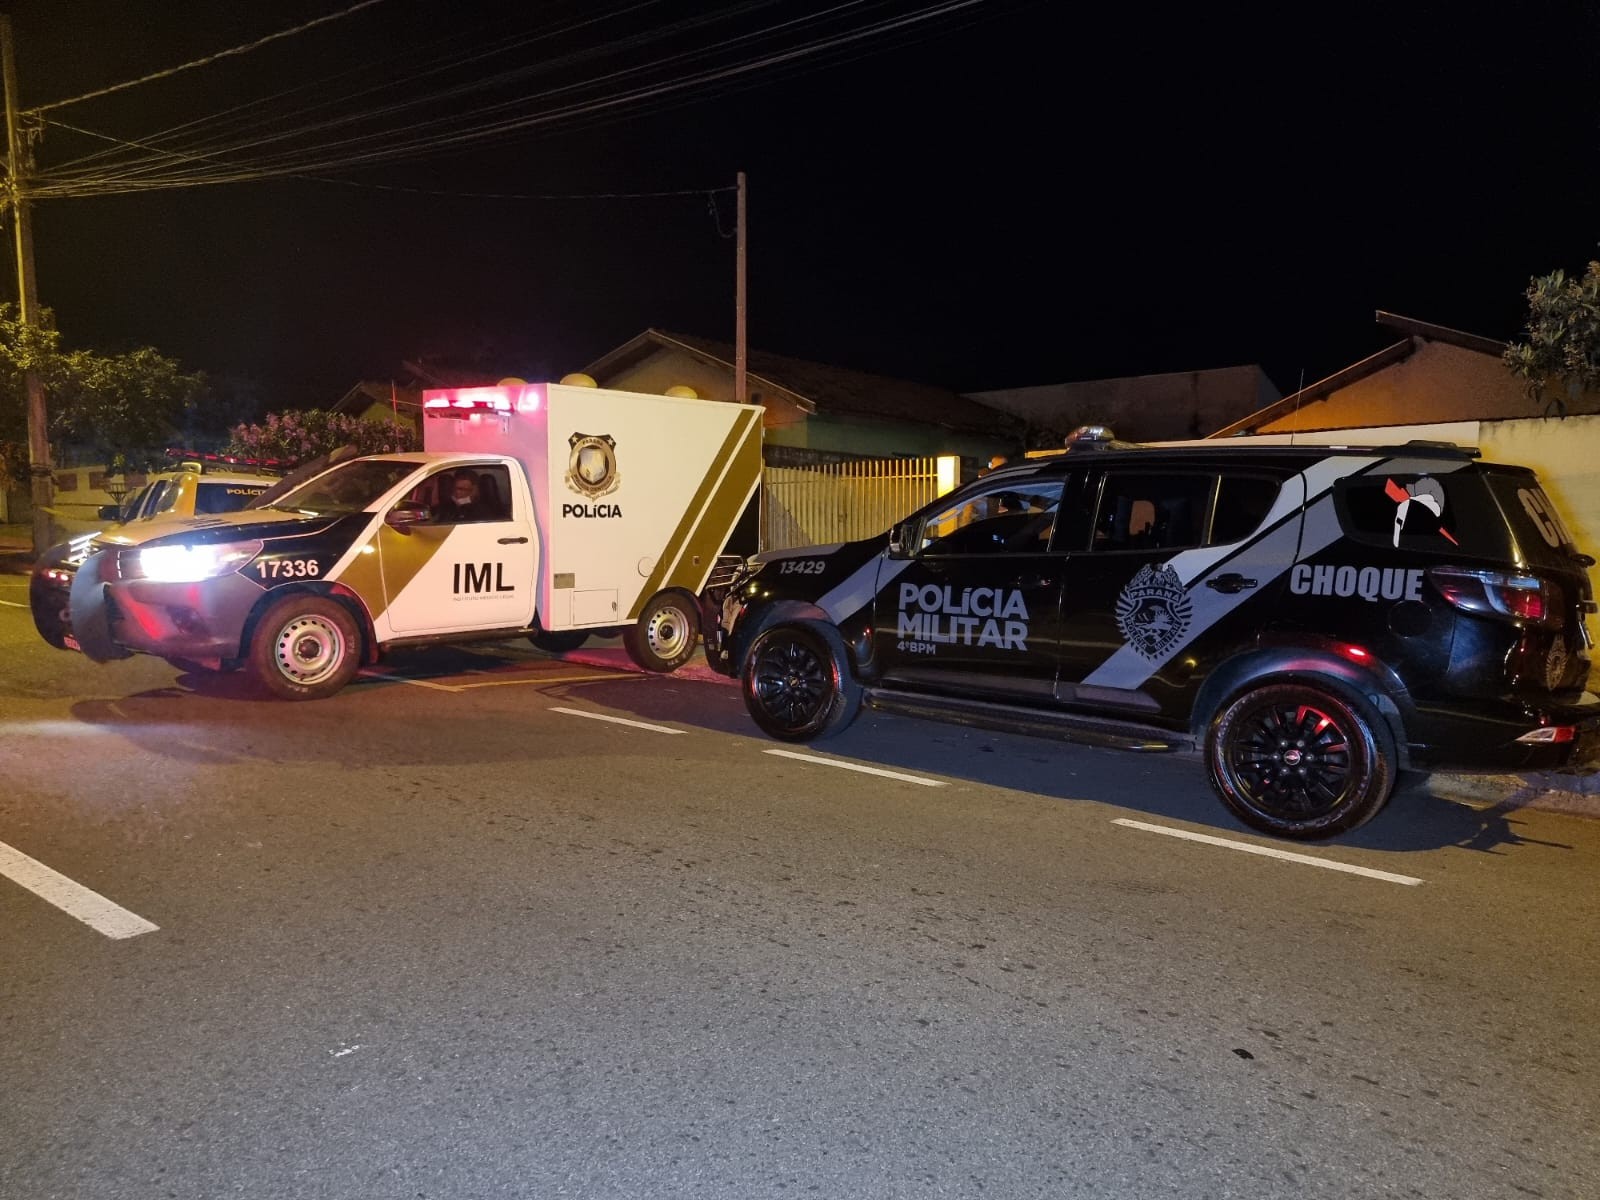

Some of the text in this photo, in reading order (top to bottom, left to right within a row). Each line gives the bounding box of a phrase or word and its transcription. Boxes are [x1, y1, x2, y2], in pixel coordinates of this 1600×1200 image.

[256, 560, 319, 578] 17336
[453, 562, 515, 594] IML
[779, 561, 826, 575] 13429
[1290, 564, 1424, 602] CHOQUE
[897, 612, 1029, 651] MILITAR
